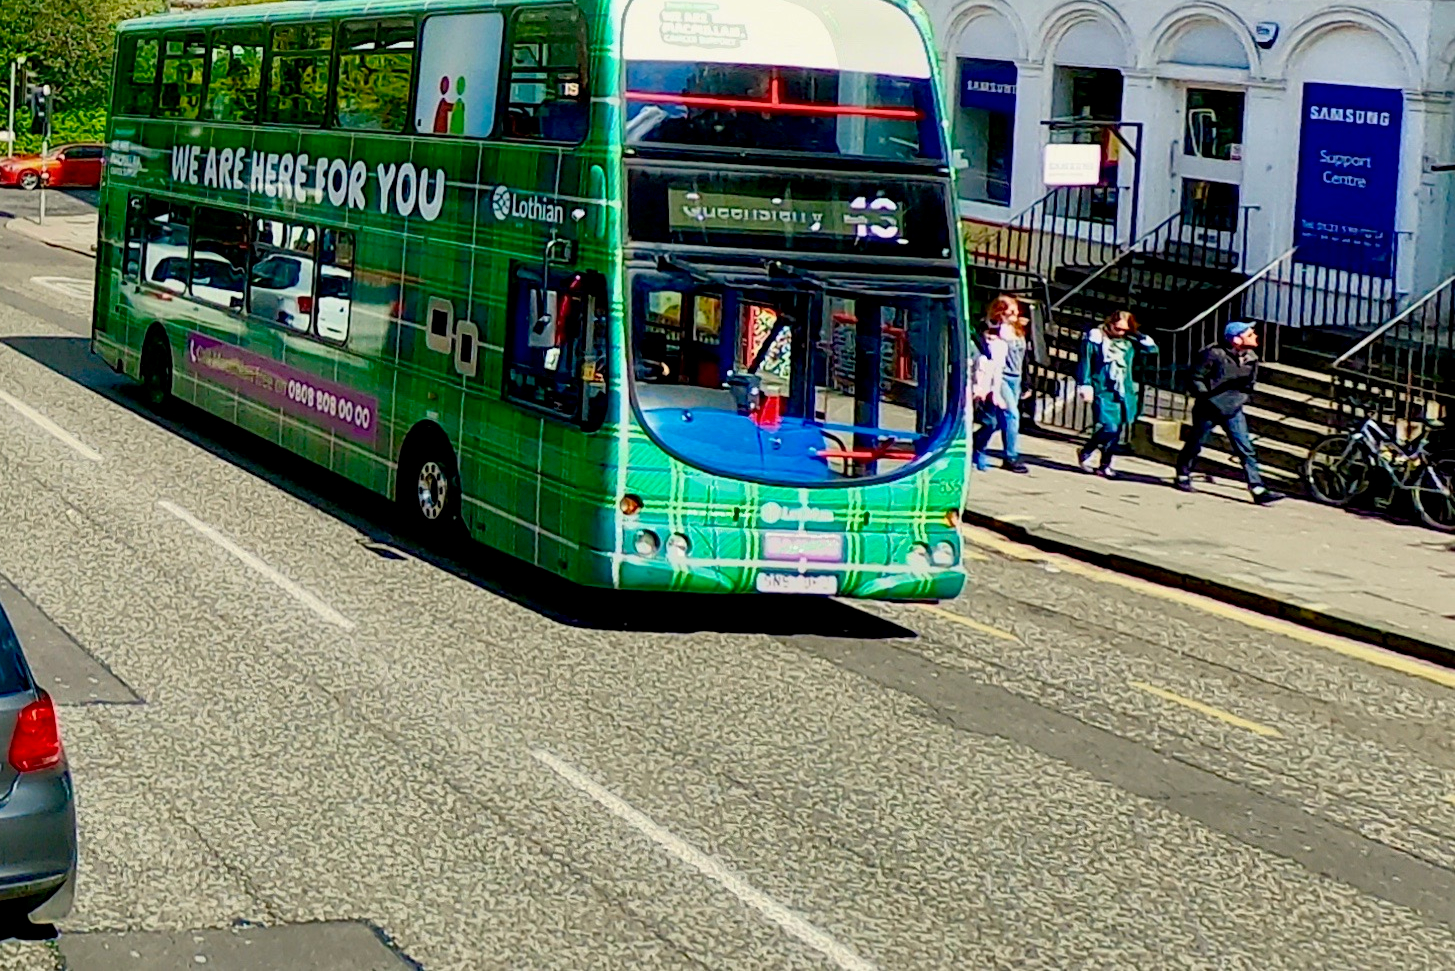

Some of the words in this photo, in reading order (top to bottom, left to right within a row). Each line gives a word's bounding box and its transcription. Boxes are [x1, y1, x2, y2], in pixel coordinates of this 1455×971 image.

[1310, 106, 1390, 126] SAMSUNG
[1319, 150, 1372, 169] Support
[172, 144, 200, 185] WE
[204, 147, 246, 190] ARE
[250, 150, 309, 203] HERE
[314, 157, 366, 211] FOR
[377, 163, 445, 221] YOU
[1322, 171, 1367, 188] Centre
[512, 193, 564, 224] Lothian
[338, 397, 353, 423] 00
[354, 404, 371, 430] 00
